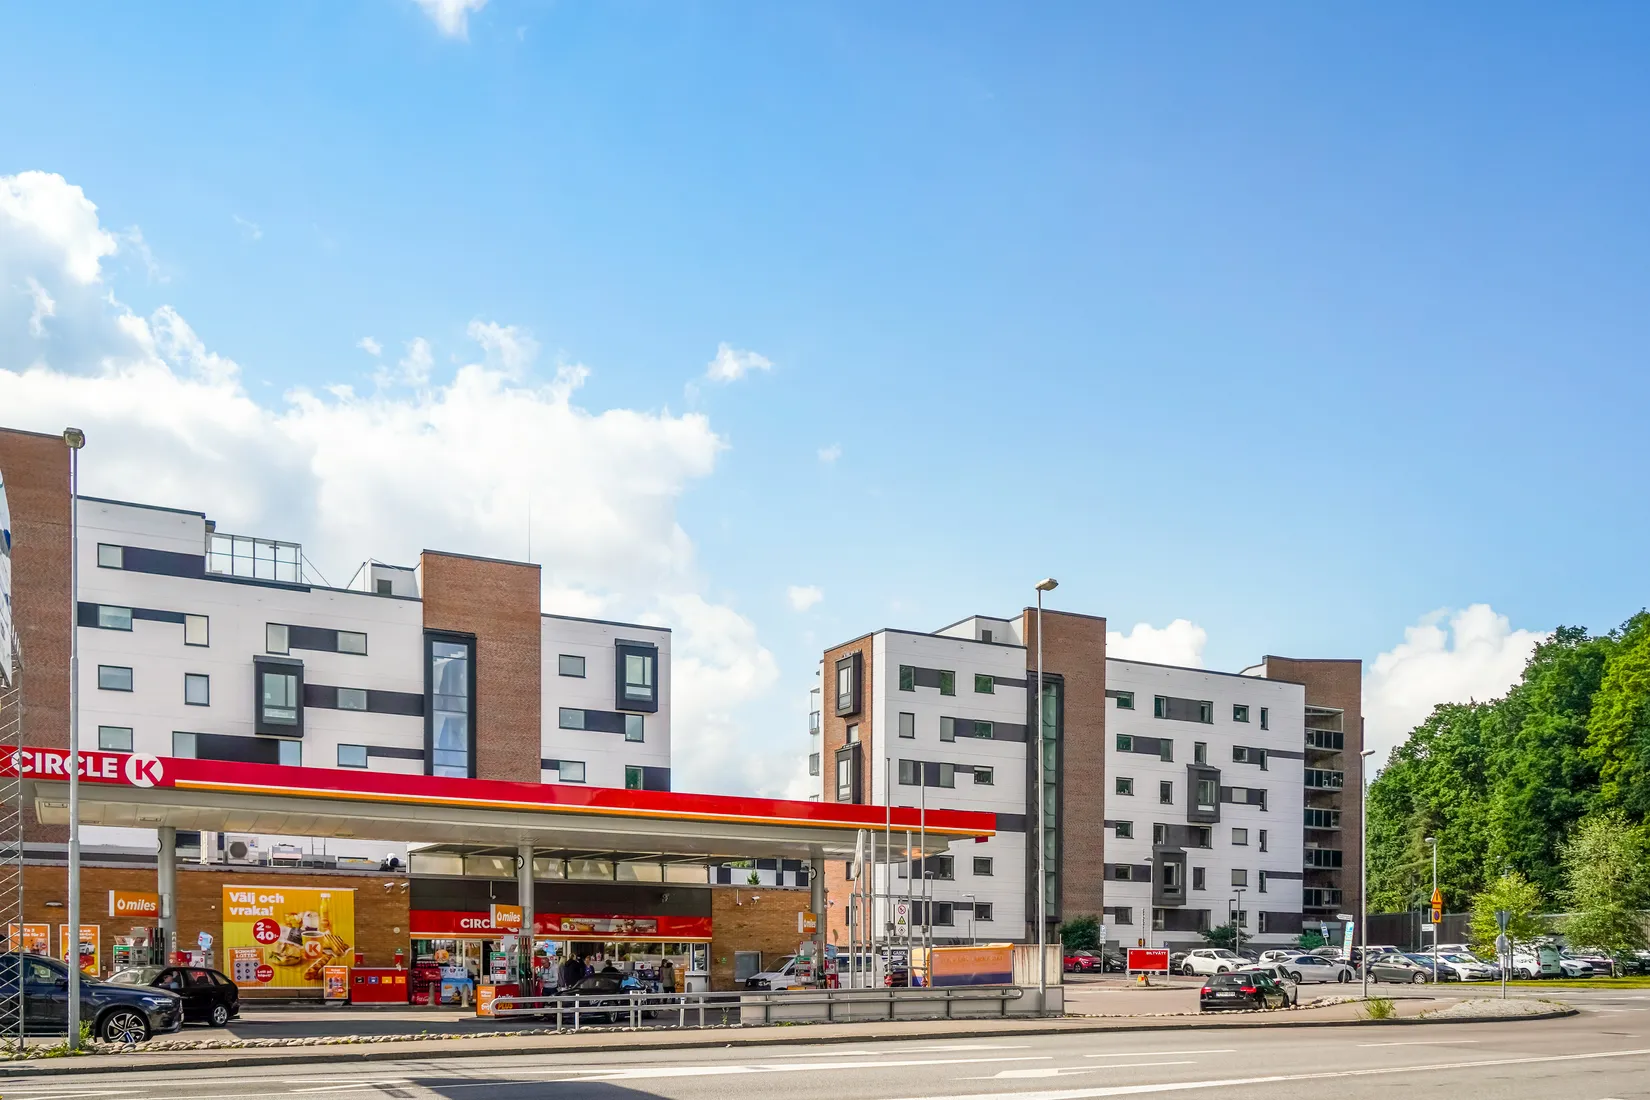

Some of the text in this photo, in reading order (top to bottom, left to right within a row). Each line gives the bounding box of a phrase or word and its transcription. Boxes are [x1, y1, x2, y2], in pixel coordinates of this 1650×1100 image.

[11, 751, 160, 787] CIRCLE K
[229, 892, 284, 904] Välj och
[126, 900, 156, 911] miles
[229, 906, 274, 916] vraka!
[502, 912, 521, 923] miles
[256, 922, 265, 931] 2
[460, 918, 503, 929] CIRC
[309, 943, 320, 953] K
